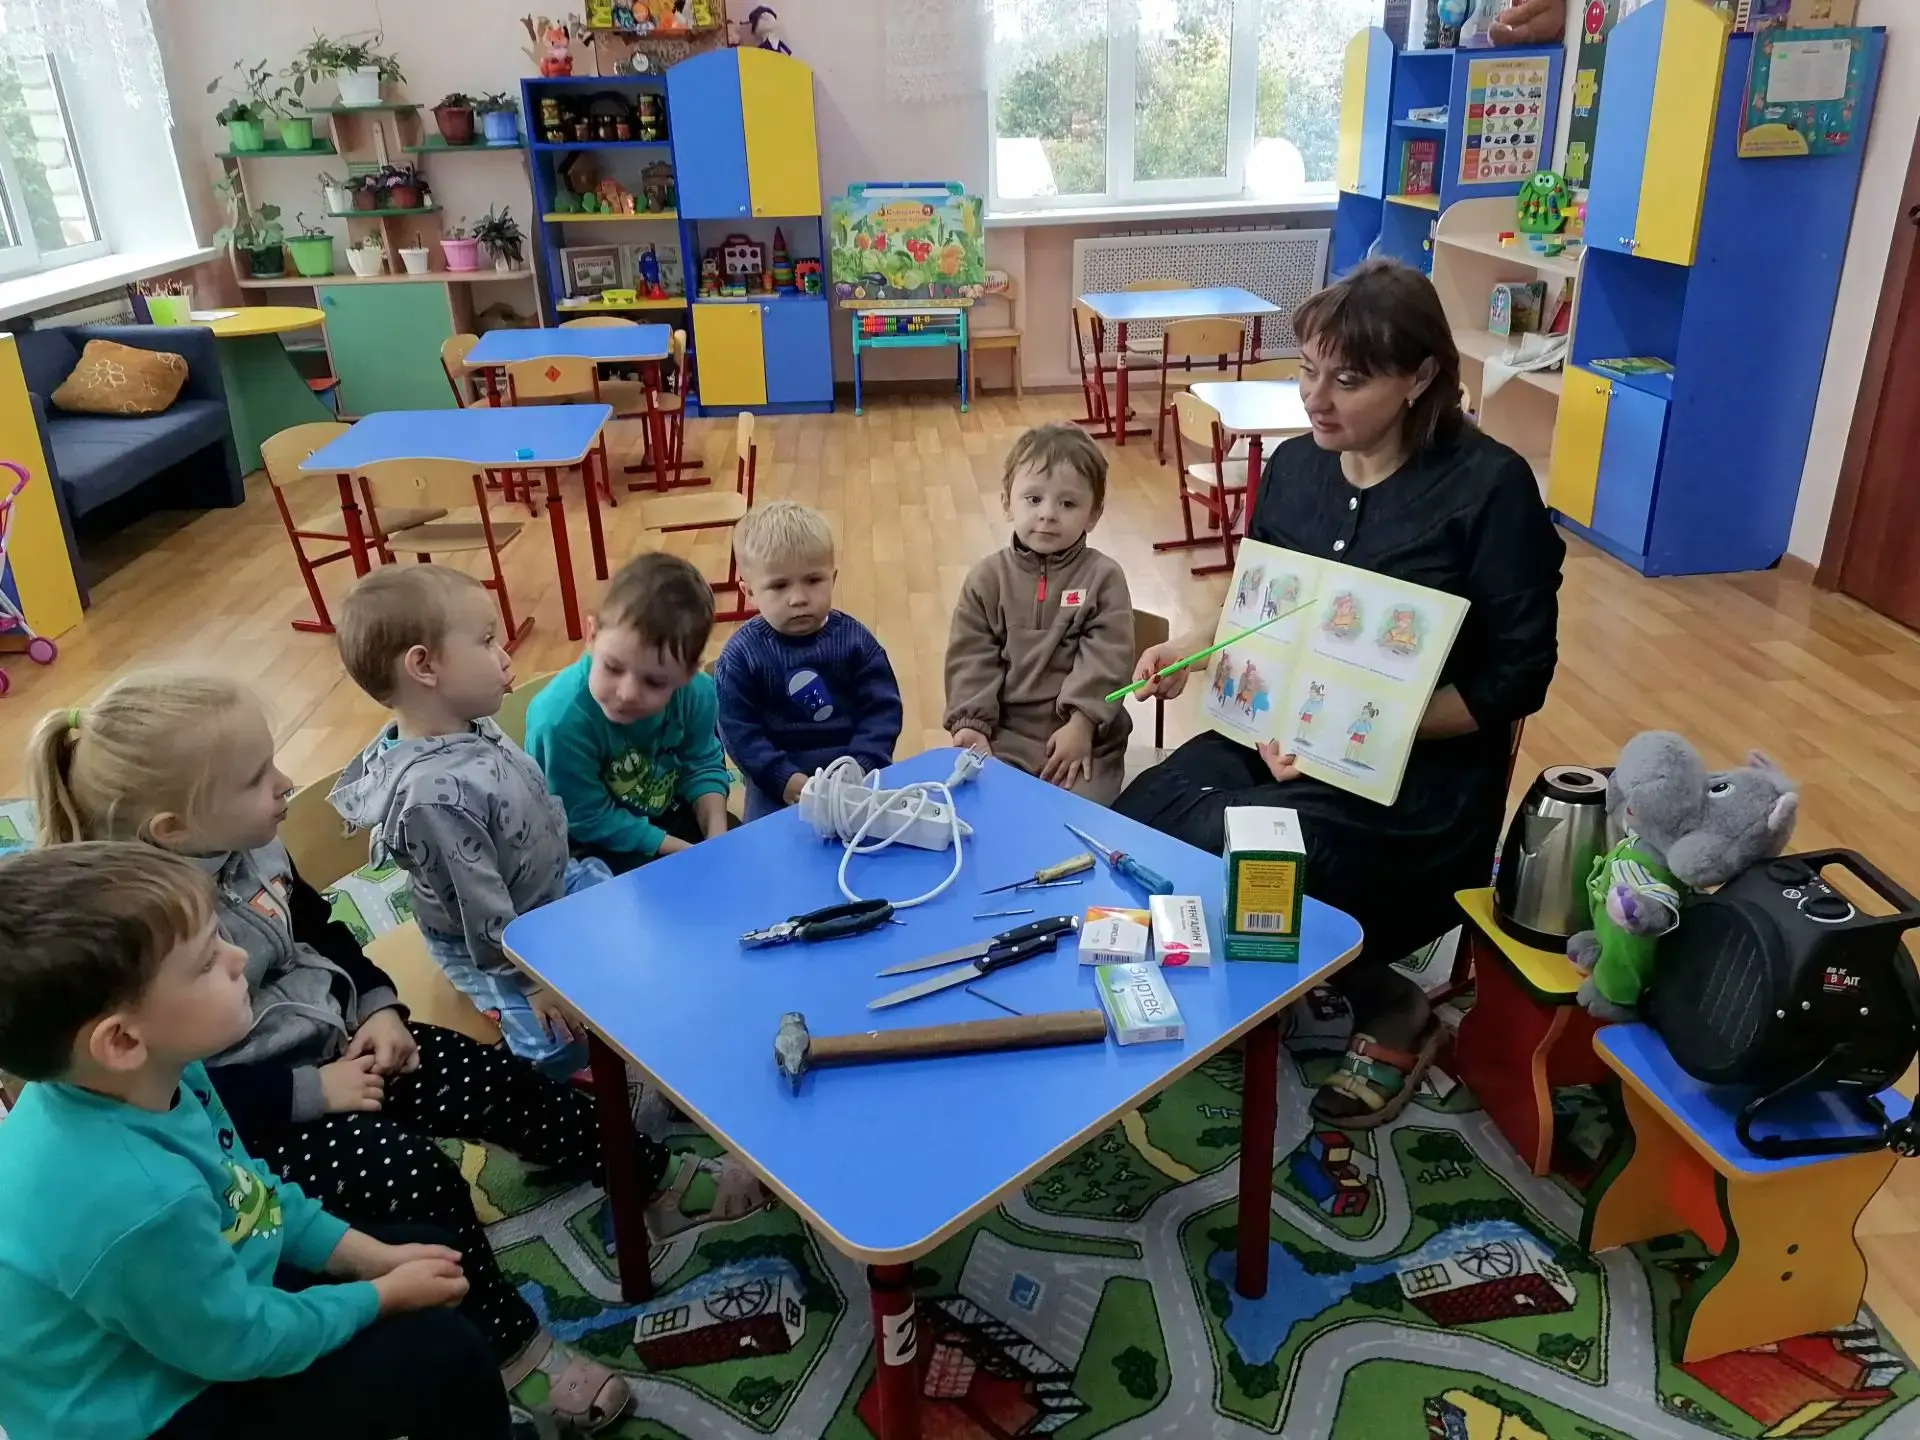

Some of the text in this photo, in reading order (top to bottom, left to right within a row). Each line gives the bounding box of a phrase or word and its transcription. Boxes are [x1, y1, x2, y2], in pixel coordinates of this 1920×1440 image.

[1120, 355, 1126, 366] 5
[1187, 904, 1202, 942] РЕНГАЛИН
[1129, 966, 1164, 1017] Зиртек
[1831, 974, 1861, 987] BAIT
[896, 1314, 917, 1357] 2
